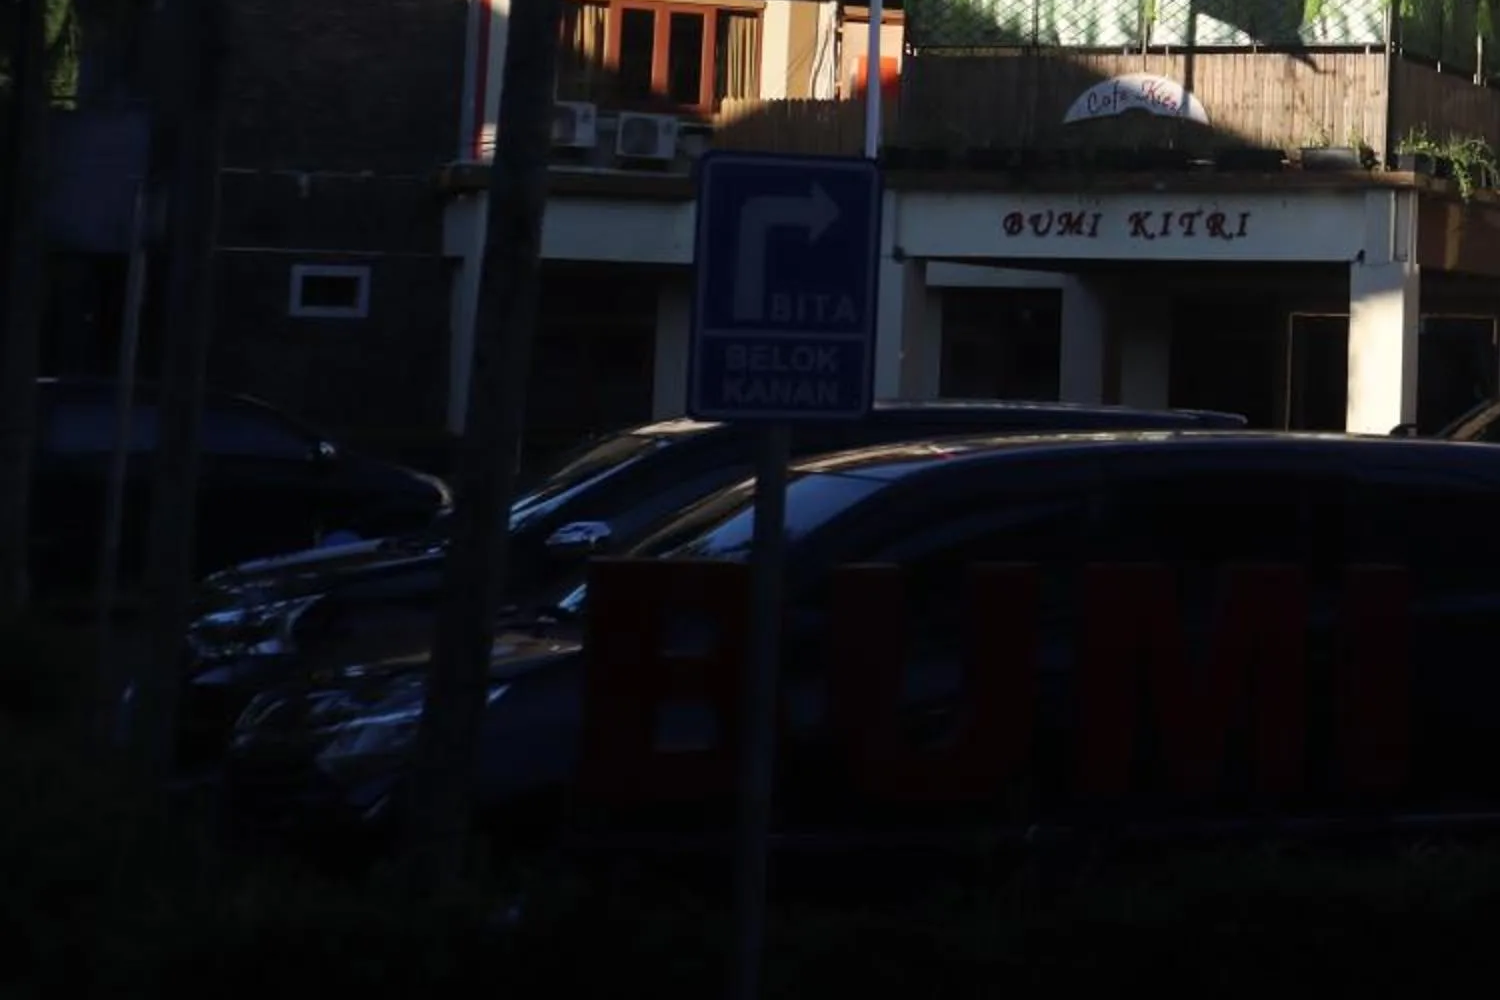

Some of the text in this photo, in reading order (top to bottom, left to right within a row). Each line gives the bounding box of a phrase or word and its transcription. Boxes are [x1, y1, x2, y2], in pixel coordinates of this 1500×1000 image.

[1003, 210, 1252, 240] BUMI KITRI
[769, 292, 859, 324] BITA
[724, 344, 840, 372] BELOK
[721, 375, 840, 405] KANAN
[574, 558, 1411, 802] BUMI
